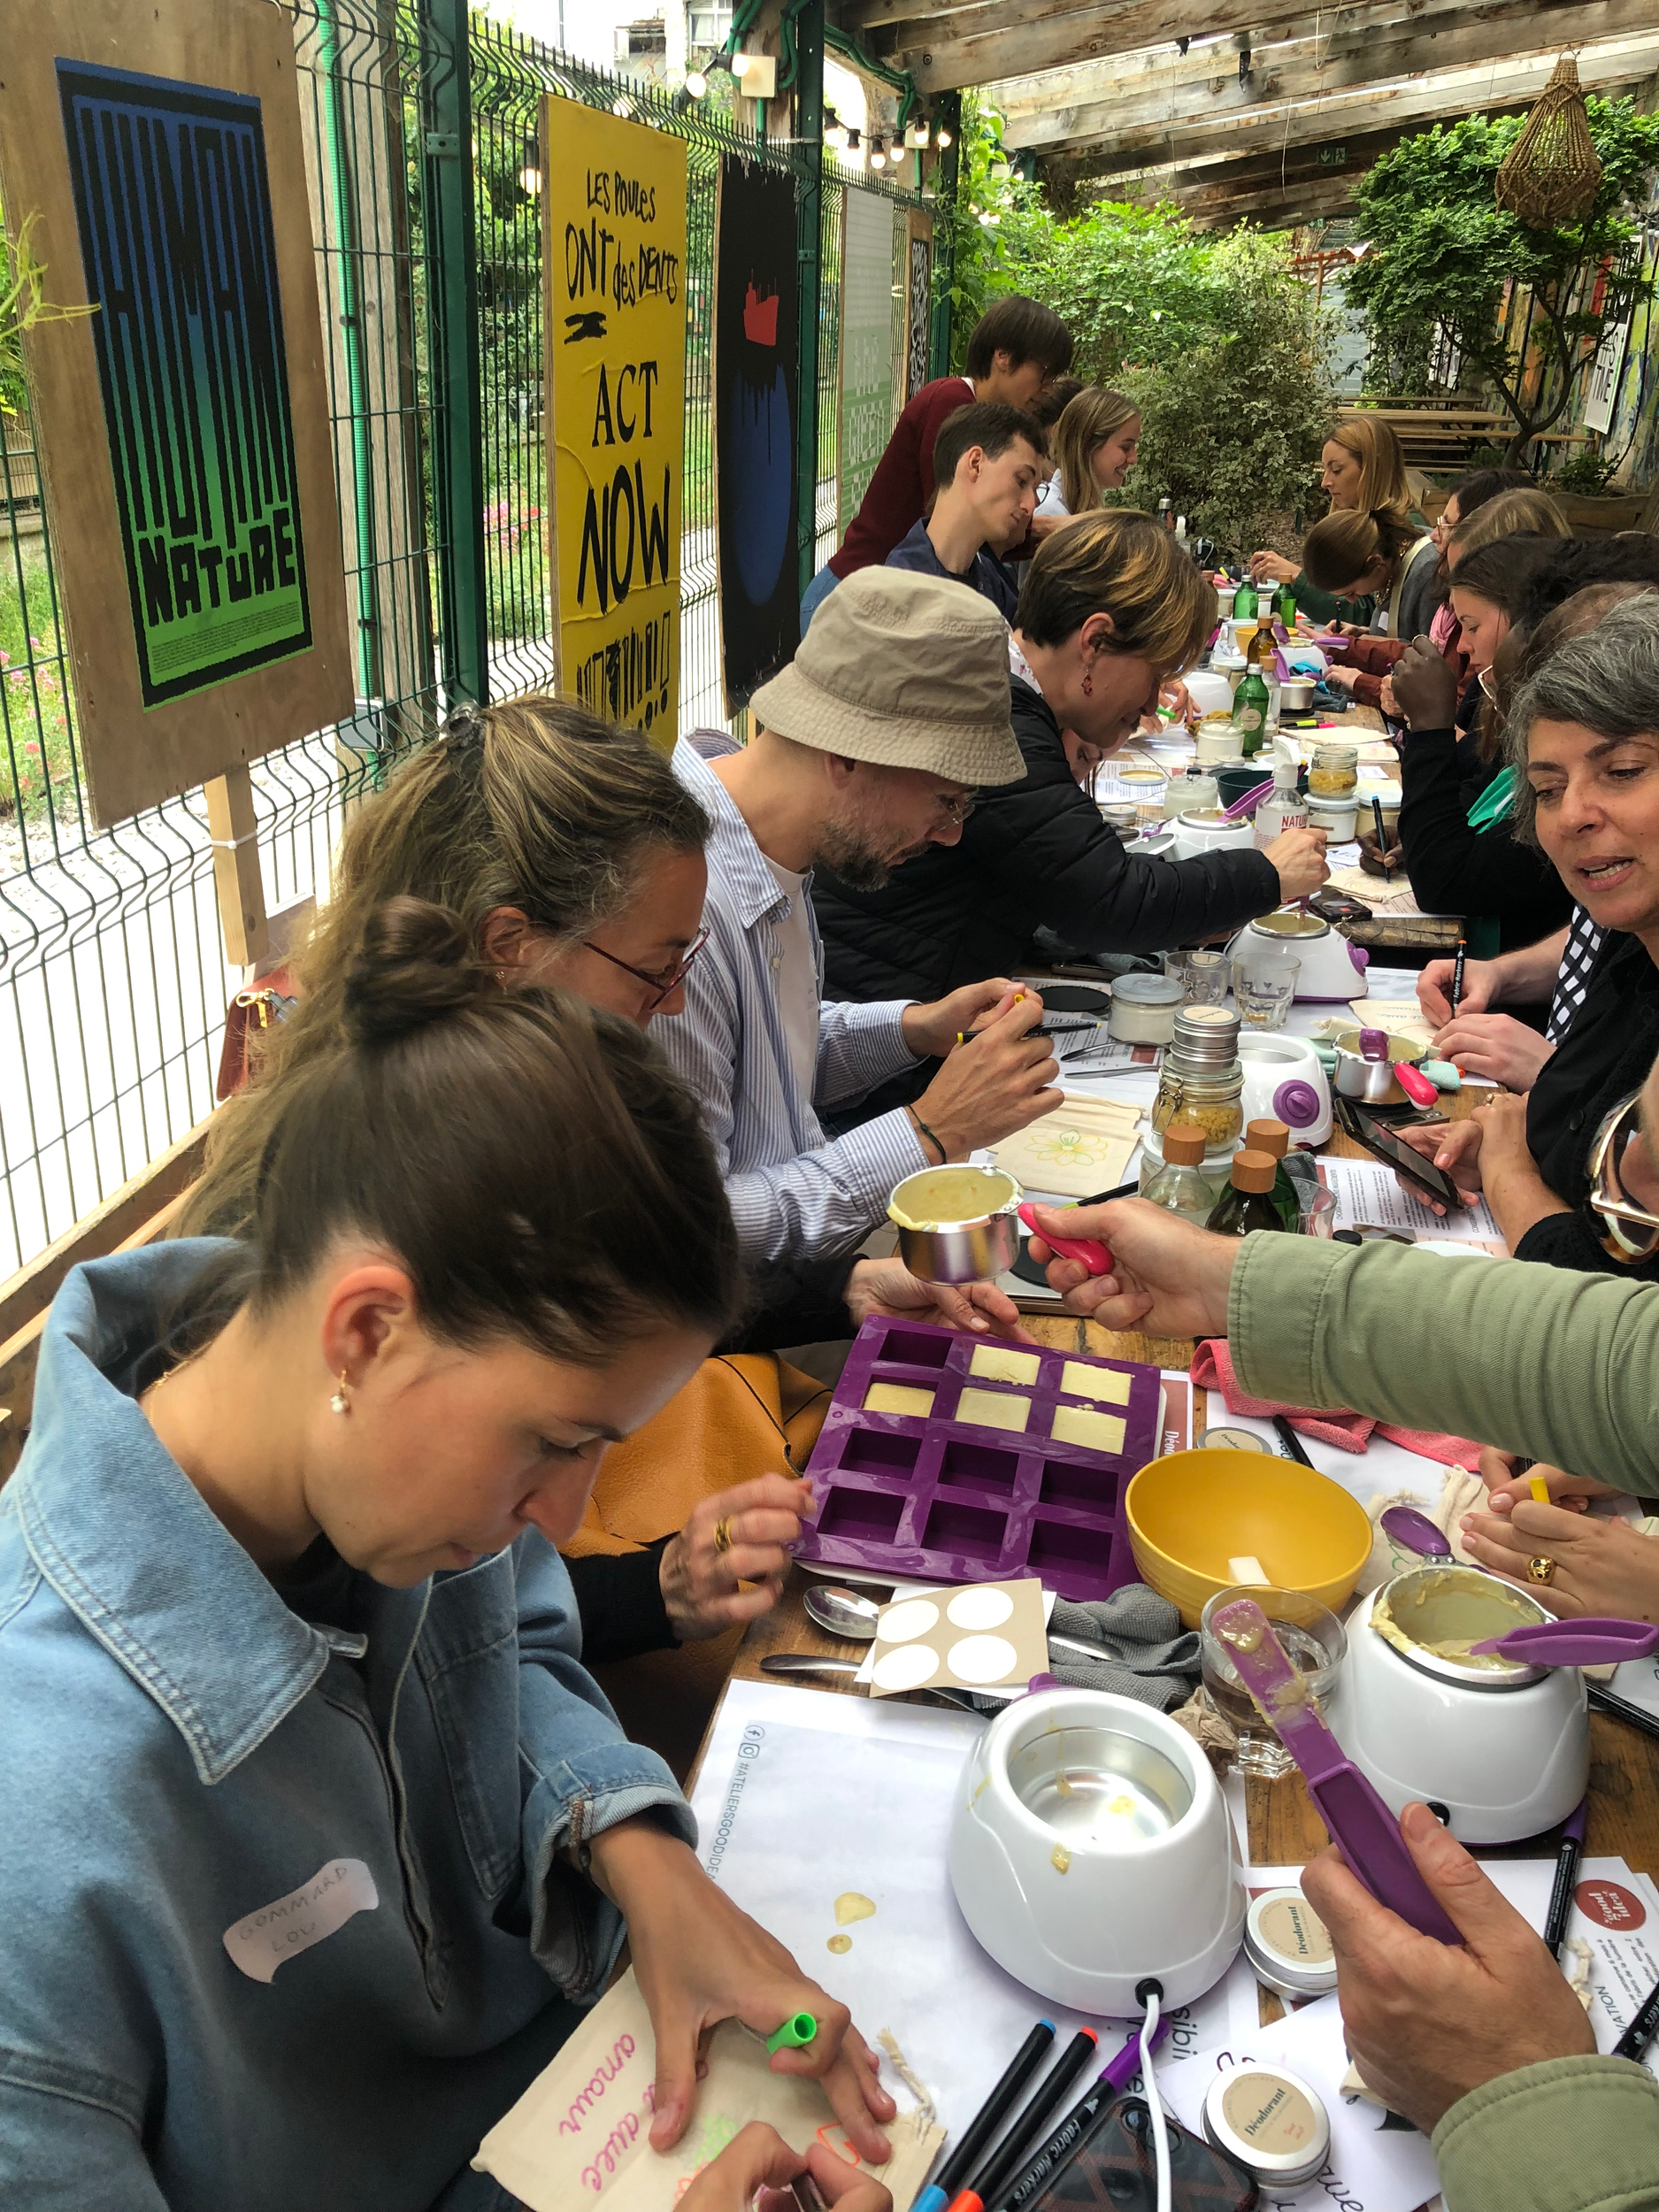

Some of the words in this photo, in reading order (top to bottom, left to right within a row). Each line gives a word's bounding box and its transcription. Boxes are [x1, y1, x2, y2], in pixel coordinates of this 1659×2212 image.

[588, 167, 611, 215] LES
[565, 217, 614, 301] ONT
[613, 240, 636, 311] des
[592, 360, 657, 447] ACT
[577, 457, 671, 616] NOW
[139, 507, 296, 627] NATURE
[1287, 1906, 1308, 1955] Déodorant
[1051, 2118, 1081, 2159] Fabric
[1244, 2087, 1286, 2145] Déodorant
[1013, 2151, 1054, 2207] Markers
